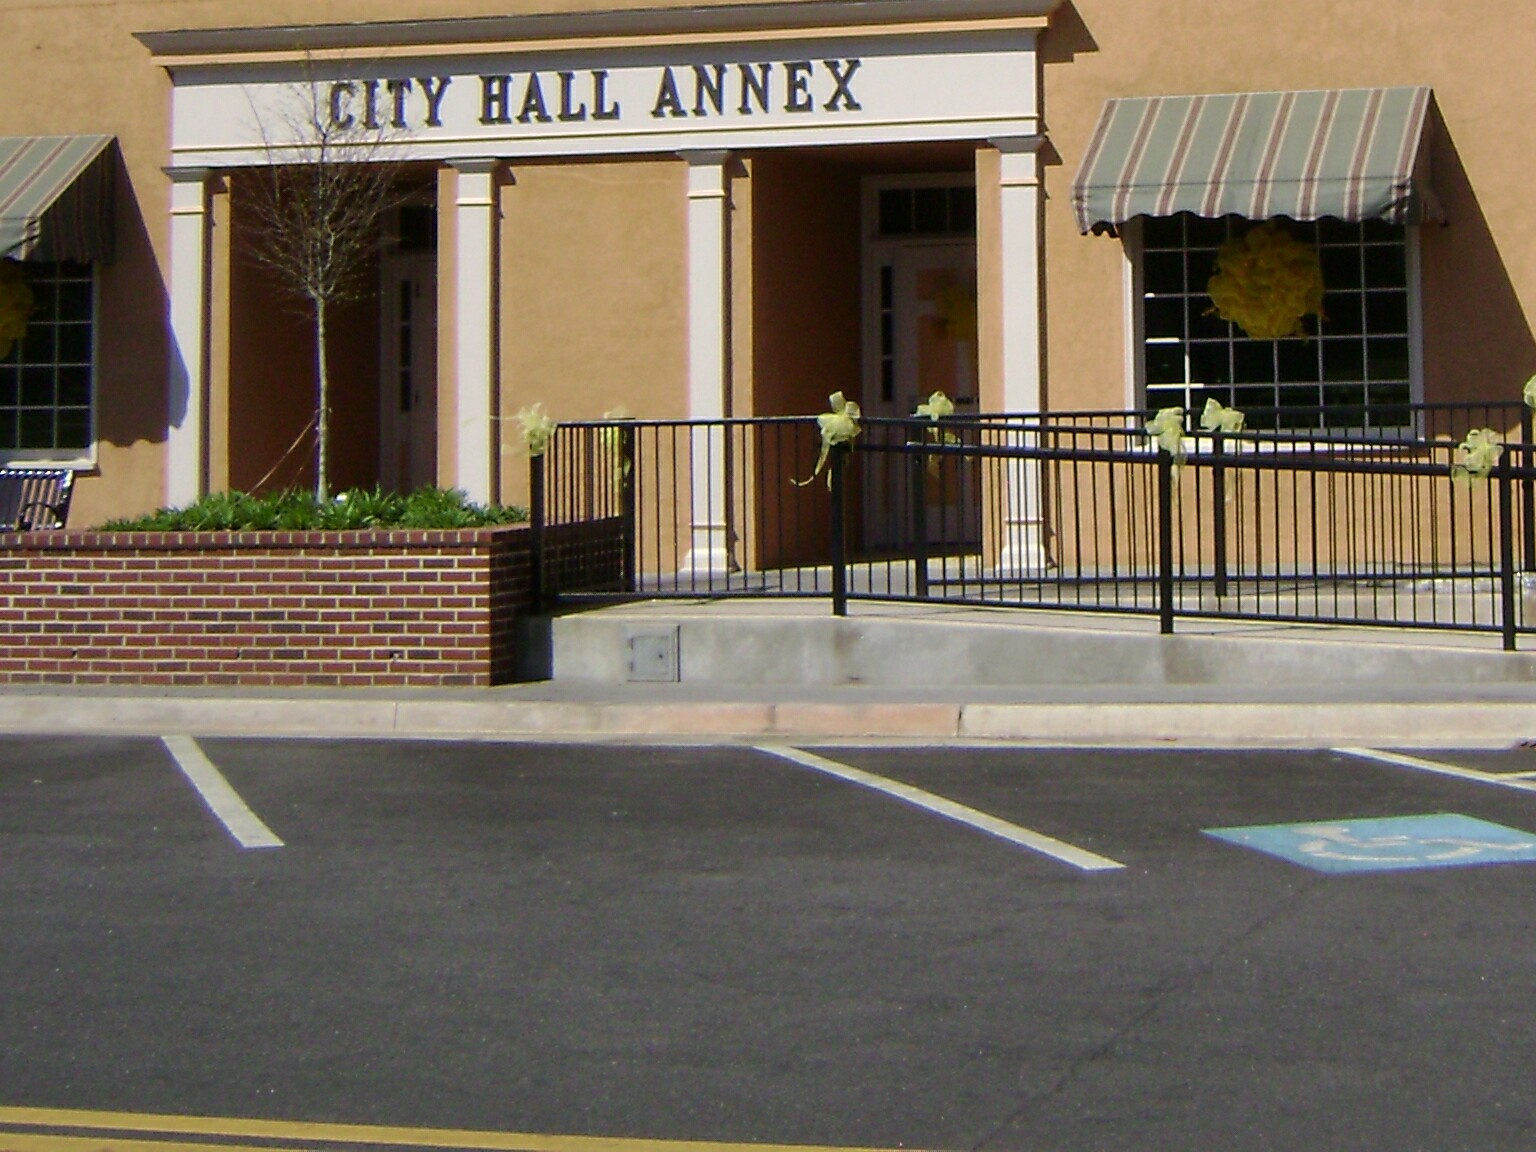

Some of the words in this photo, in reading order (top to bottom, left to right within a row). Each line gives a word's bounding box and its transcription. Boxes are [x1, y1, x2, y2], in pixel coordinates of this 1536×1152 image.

[329, 76, 452, 130] CITY
[478, 69, 621, 125] HALL
[651, 58, 862, 118] ANNEX
